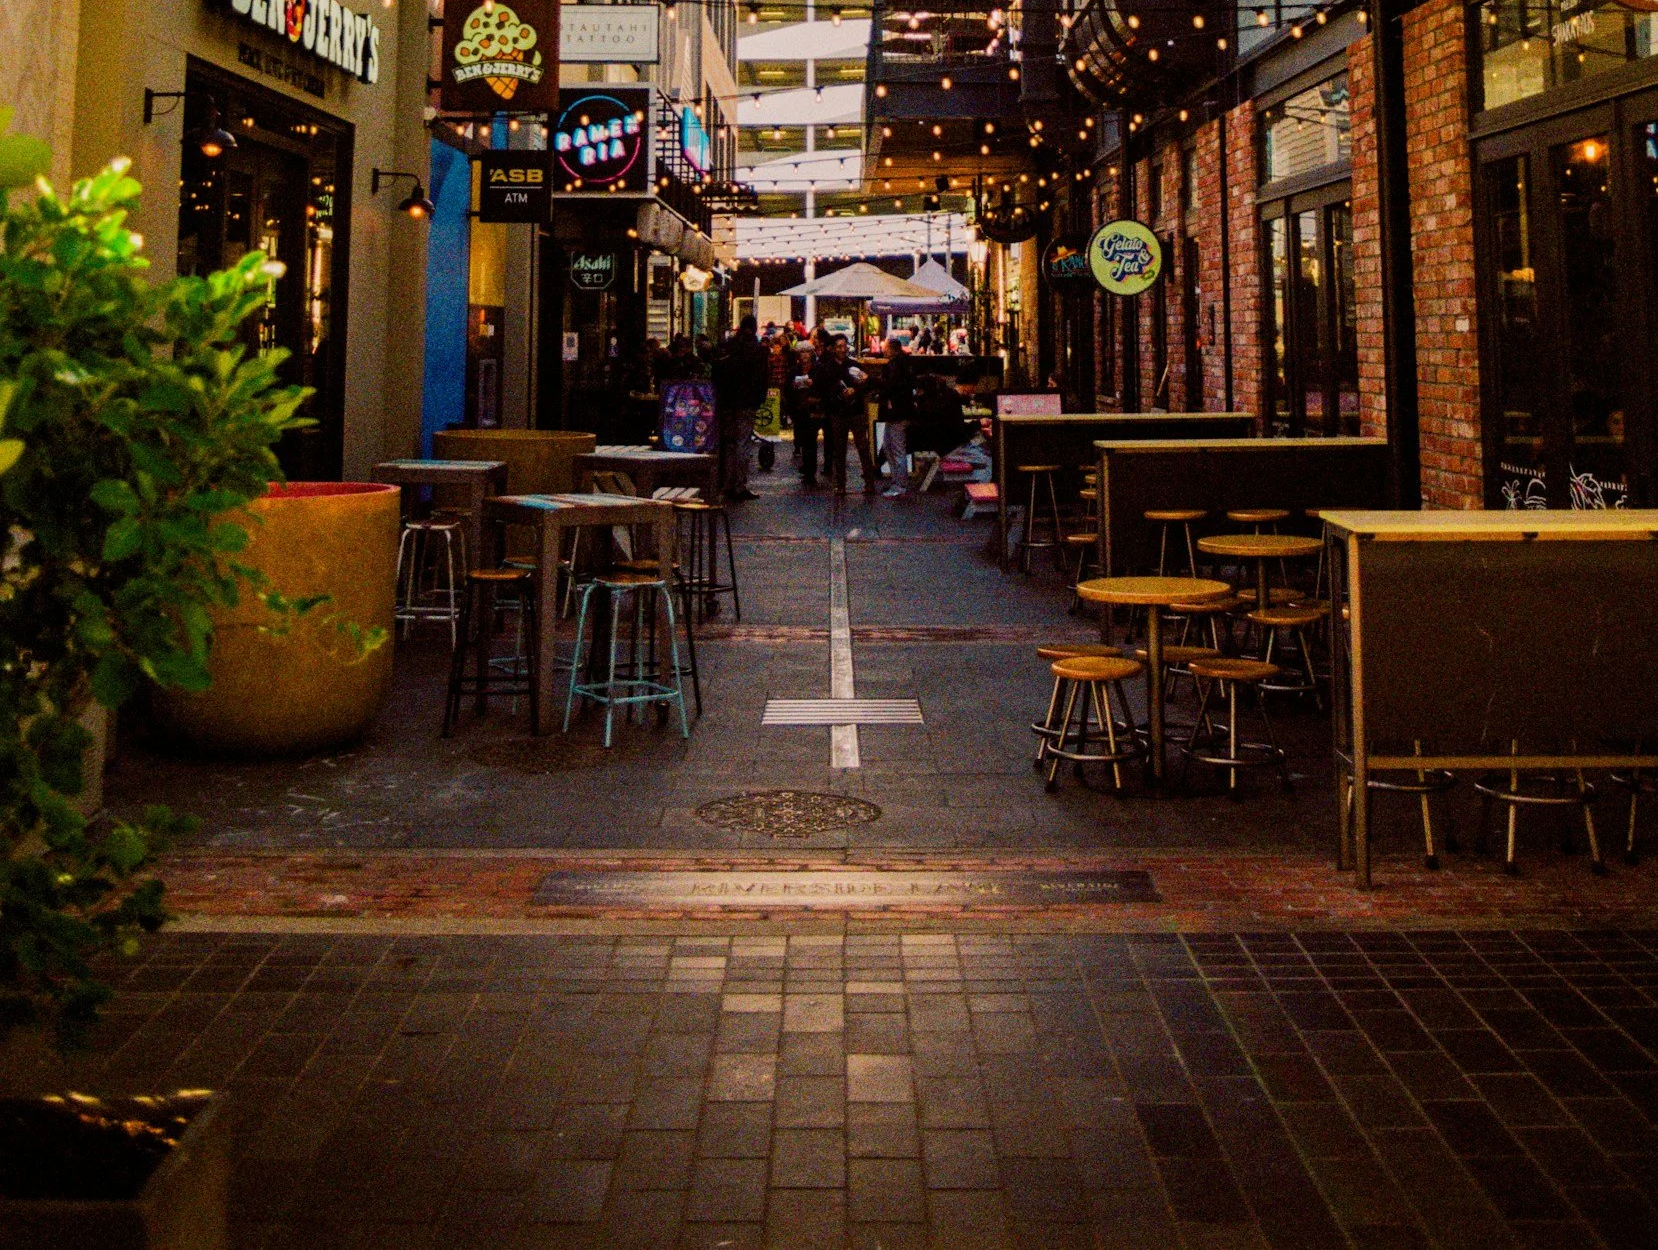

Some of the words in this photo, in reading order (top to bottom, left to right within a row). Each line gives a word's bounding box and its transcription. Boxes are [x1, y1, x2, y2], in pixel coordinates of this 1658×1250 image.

[560, 23, 647, 32] TAUTAHI
[566, 34, 635, 44] TATTOO
[553, 113, 642, 152] RAMEN
[578, 138, 627, 166] RIA
[490, 168, 544, 183] ASB
[504, 192, 528, 204] ATM
[1098, 232, 1144, 259] Gelato
[573, 254, 611, 271] Asahi
[1110, 252, 1140, 279] Tea
